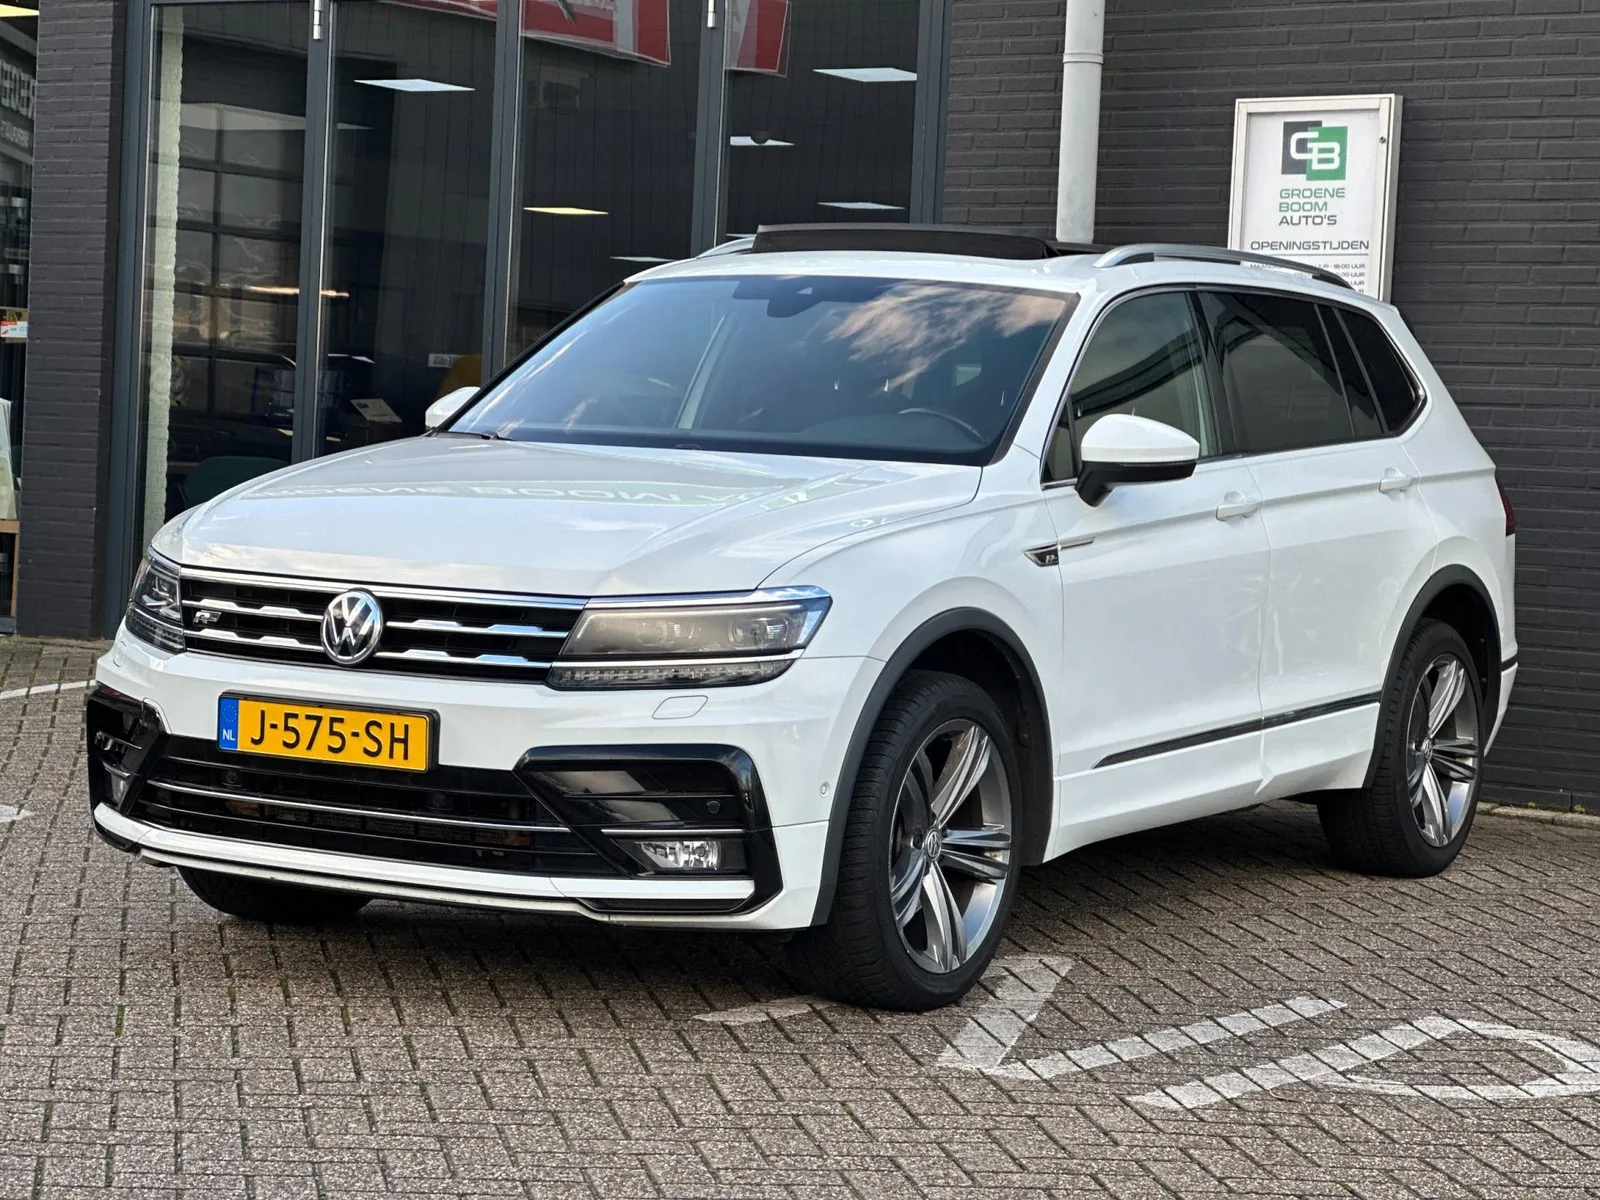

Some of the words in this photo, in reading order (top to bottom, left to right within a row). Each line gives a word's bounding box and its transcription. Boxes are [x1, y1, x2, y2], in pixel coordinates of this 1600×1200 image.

[1279, 187, 1346, 199] GROENE
[1279, 201, 1328, 212] BOOM
[1278, 214, 1338, 226] AUTO'S
[1250, 240, 1370, 250] OPENINGSTIJDEN
[222, 729, 236, 741] NL
[250, 709, 409, 761] J-575-SH
